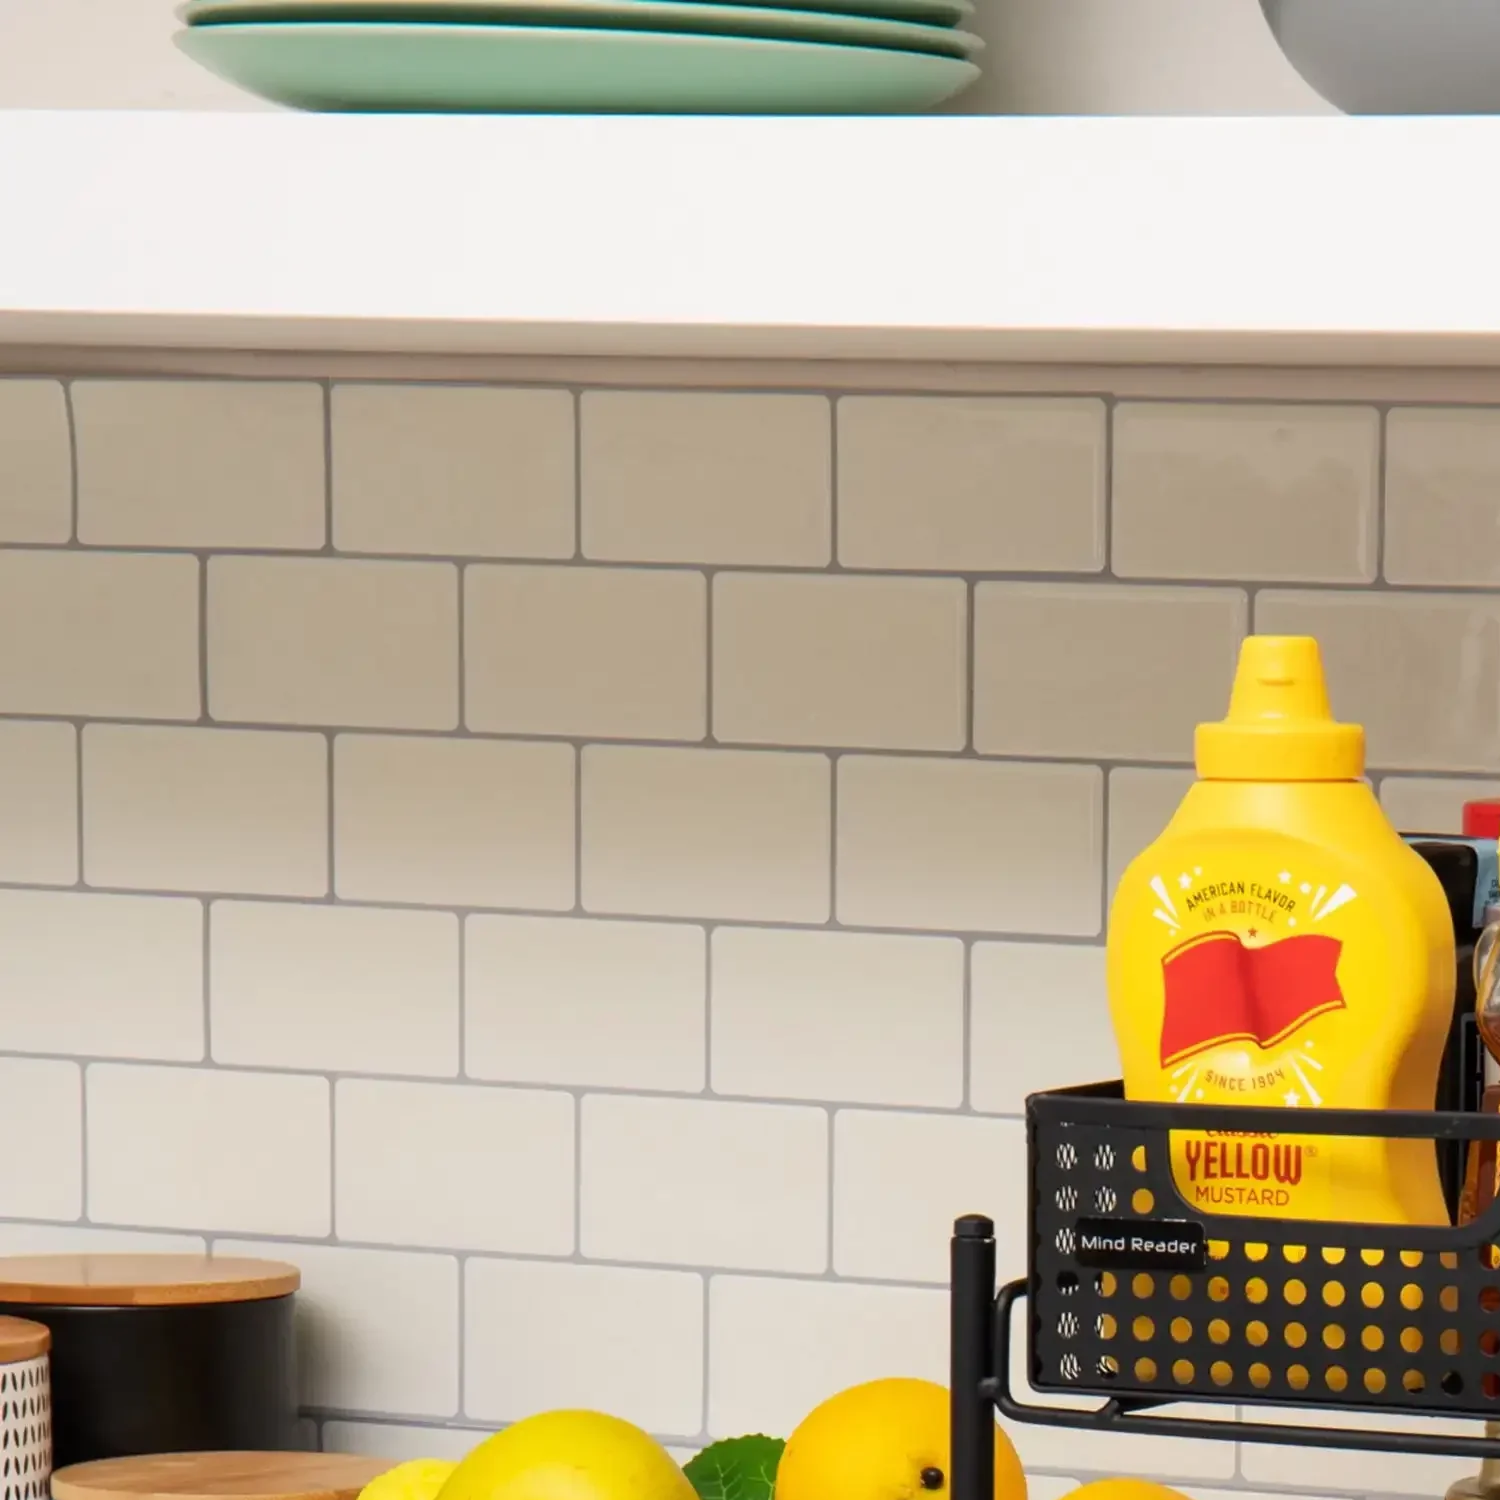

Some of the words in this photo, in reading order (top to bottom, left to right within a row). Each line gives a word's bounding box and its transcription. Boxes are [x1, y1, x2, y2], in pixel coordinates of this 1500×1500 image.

[1186, 881, 1245, 912] AMERICAN
[1250, 883, 1296, 912] FLAVOR
[1203, 907, 1216, 922] IN
[1220, 903, 1227, 915] A
[1231, 900, 1278, 923] BOTTLE
[1205, 1069, 1247, 1092] SINCE
[1185, 1140, 1303, 1186] YELLOW
[1195, 1186, 1290, 1206] MUSTARD
[1081, 1235, 1125, 1251] Mind
[1131, 1237, 1197, 1254] Reader
